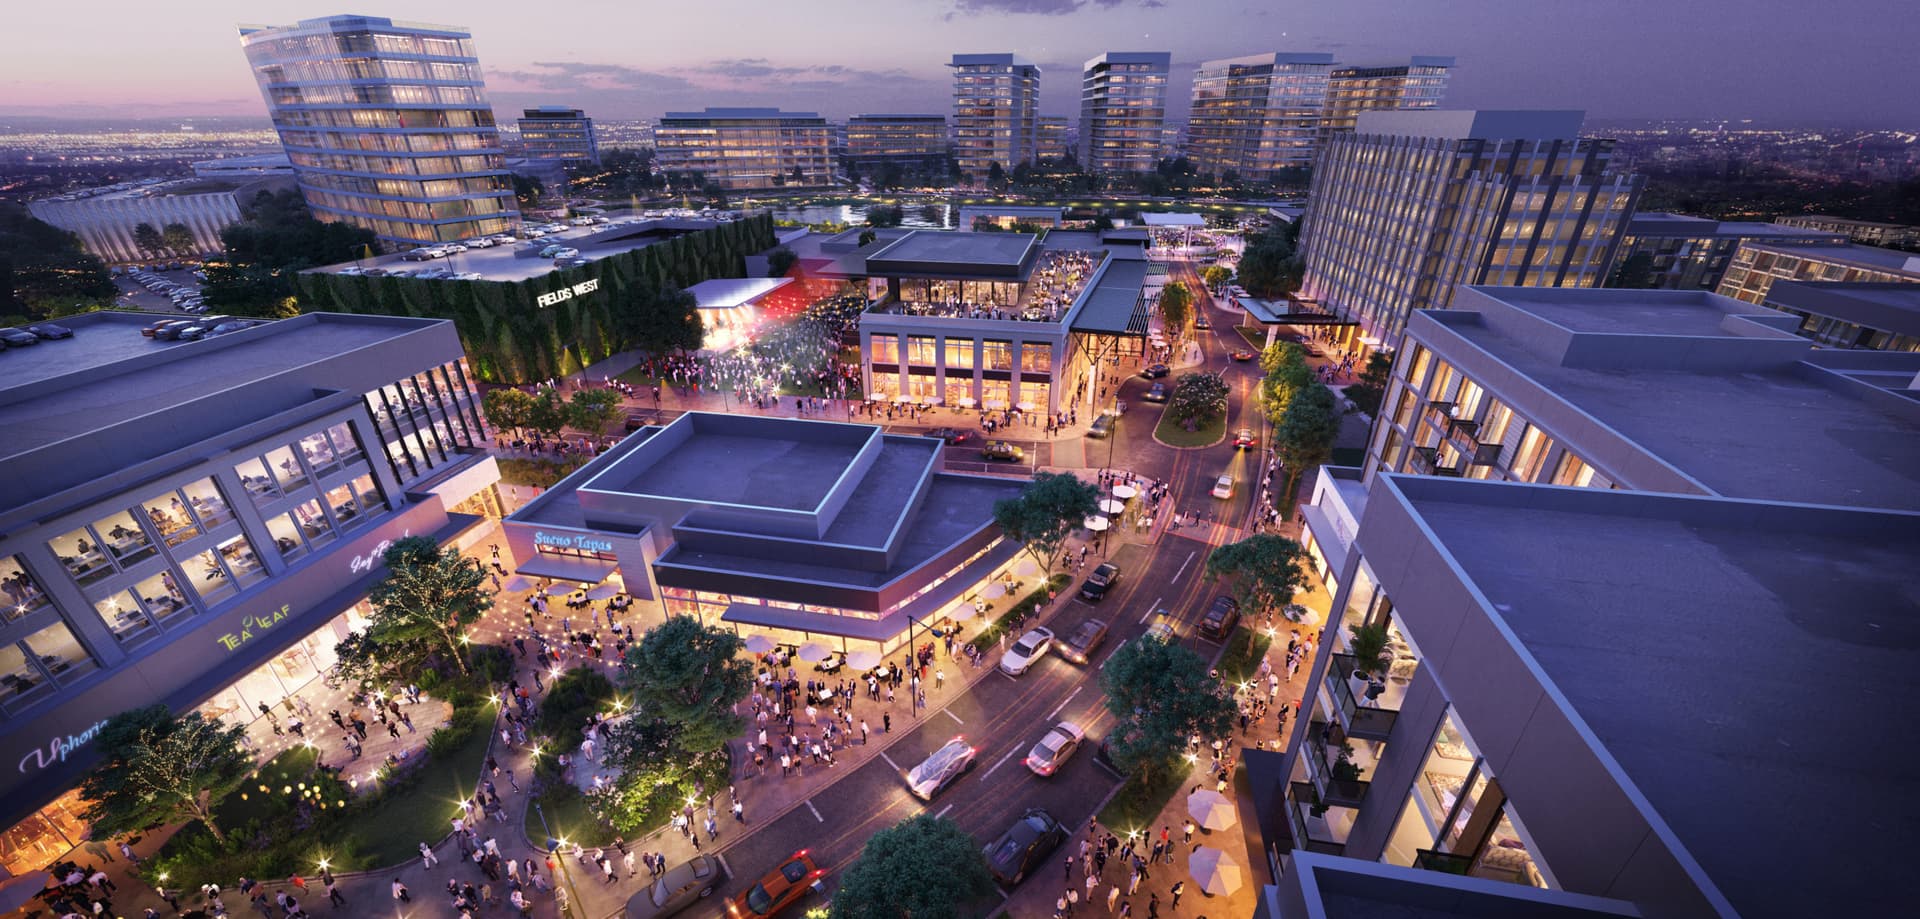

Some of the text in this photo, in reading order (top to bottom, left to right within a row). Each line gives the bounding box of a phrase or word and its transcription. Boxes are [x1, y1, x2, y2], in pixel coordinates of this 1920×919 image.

[537, 278, 599, 308] FIELDS WEST
[573, 535, 612, 553] Tapas
[217, 604, 290, 651] TEA LEAF
